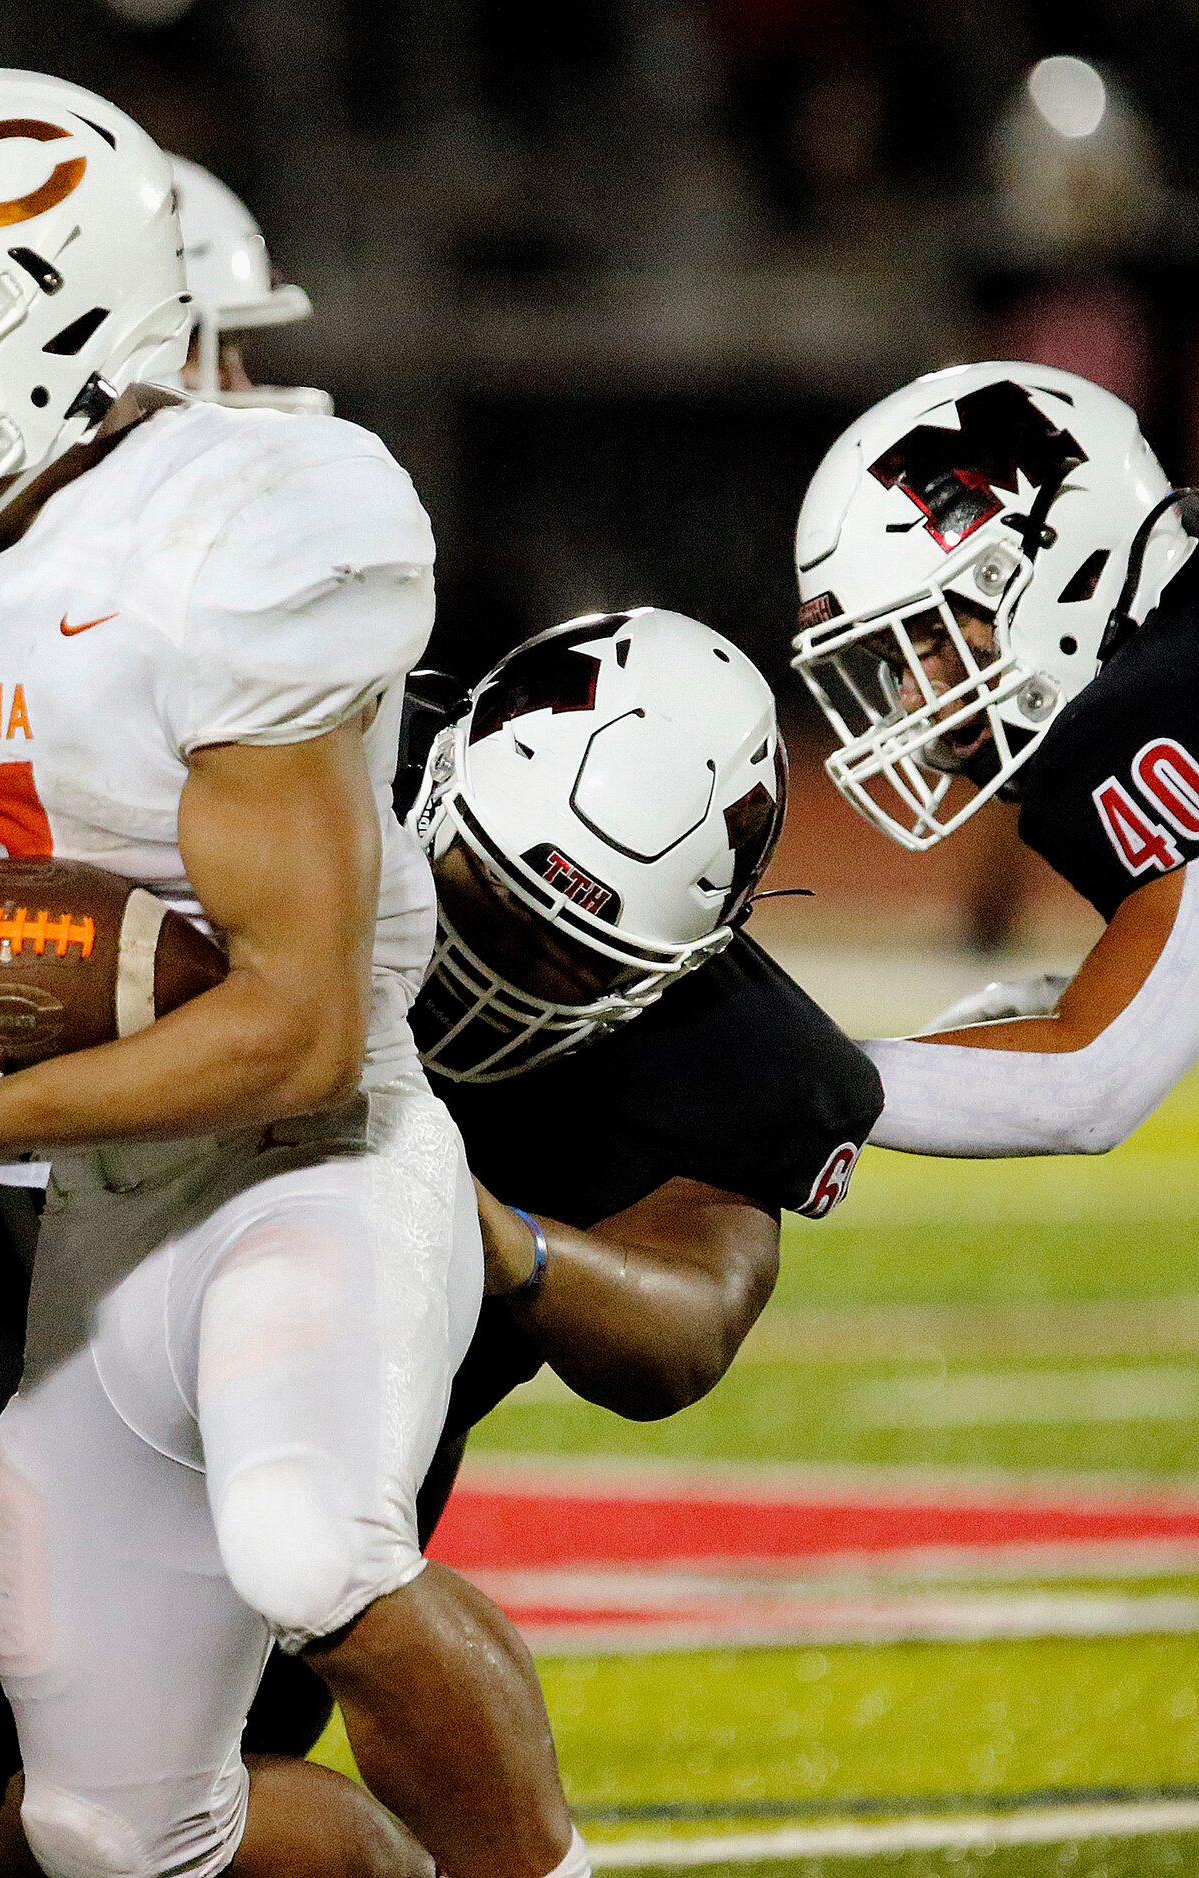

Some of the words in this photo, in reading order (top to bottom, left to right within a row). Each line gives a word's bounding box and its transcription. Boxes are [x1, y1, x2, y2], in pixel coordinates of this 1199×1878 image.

[1092, 738, 1199, 877] 40
[544, 850, 613, 916] TTH
[797, 1142, 858, 1219] 6
